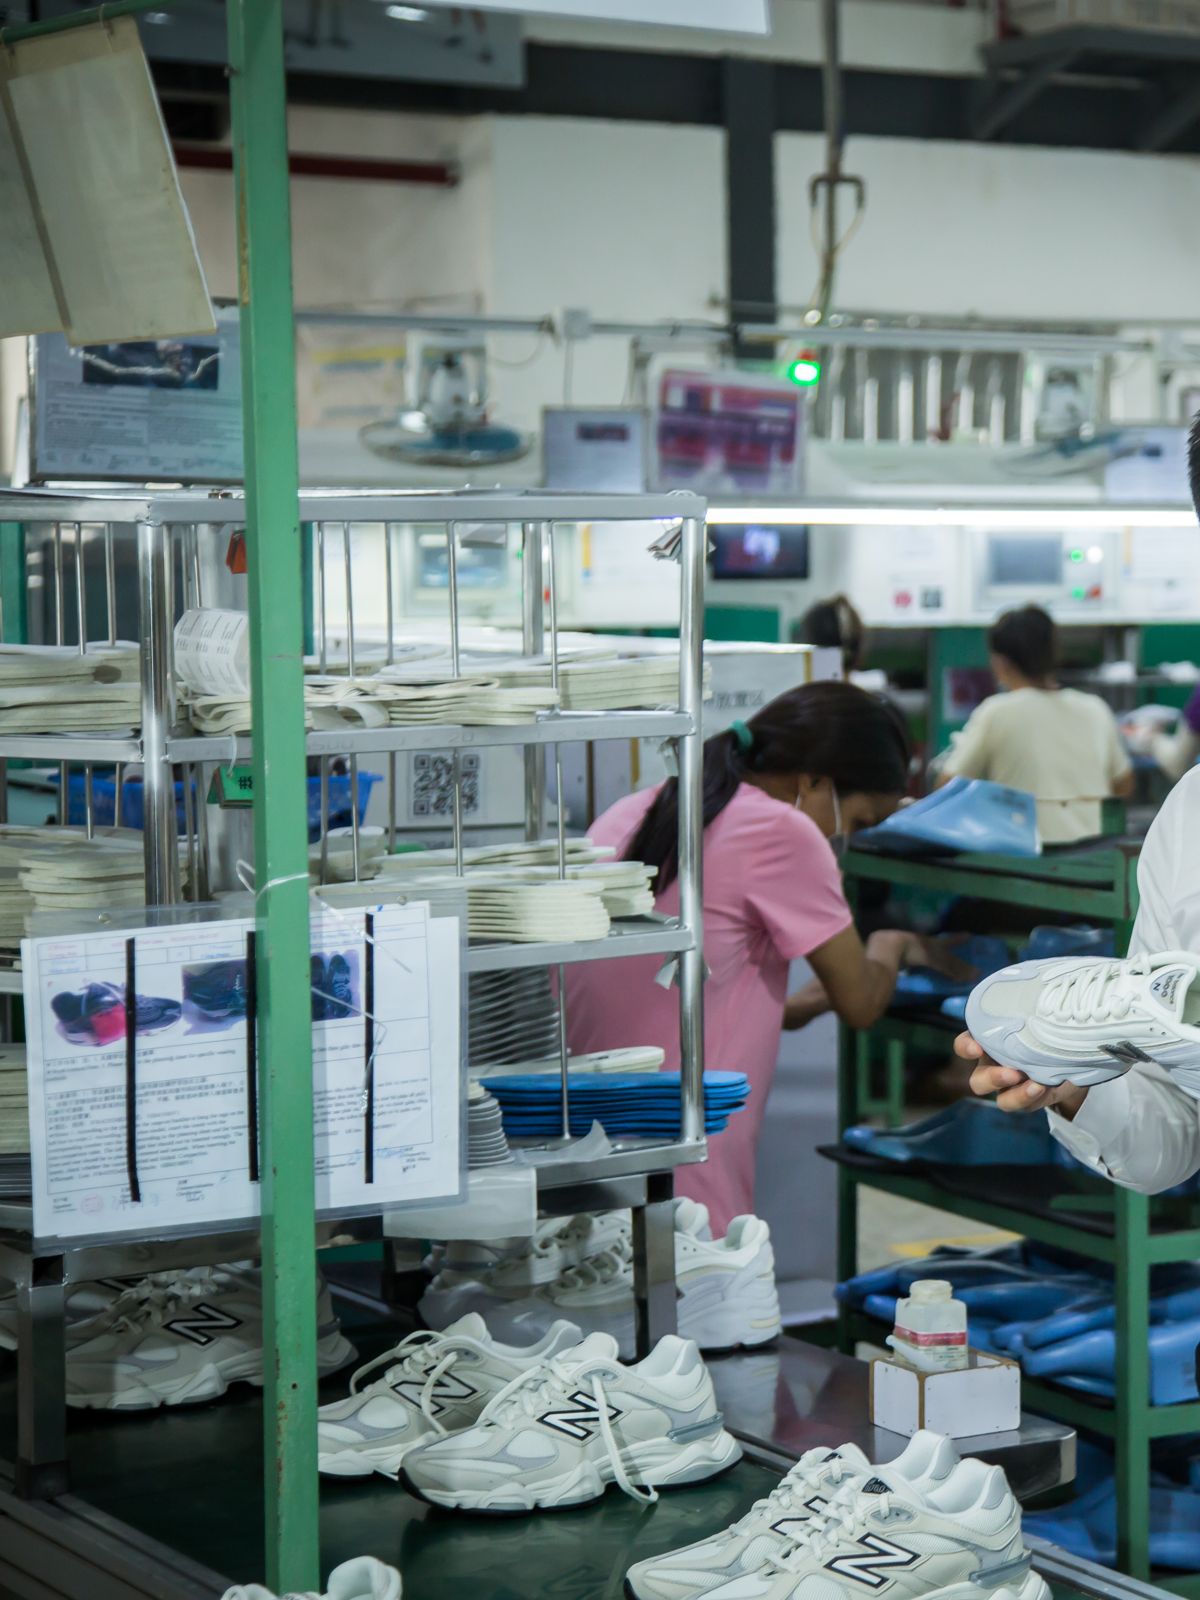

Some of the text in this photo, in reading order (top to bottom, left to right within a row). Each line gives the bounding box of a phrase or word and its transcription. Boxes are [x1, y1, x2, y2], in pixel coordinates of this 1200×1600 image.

[162, 1302, 243, 1346] N
[390, 1364, 479, 1415] N
[536, 1390, 624, 1442] N
[822, 1531, 922, 1589] N
